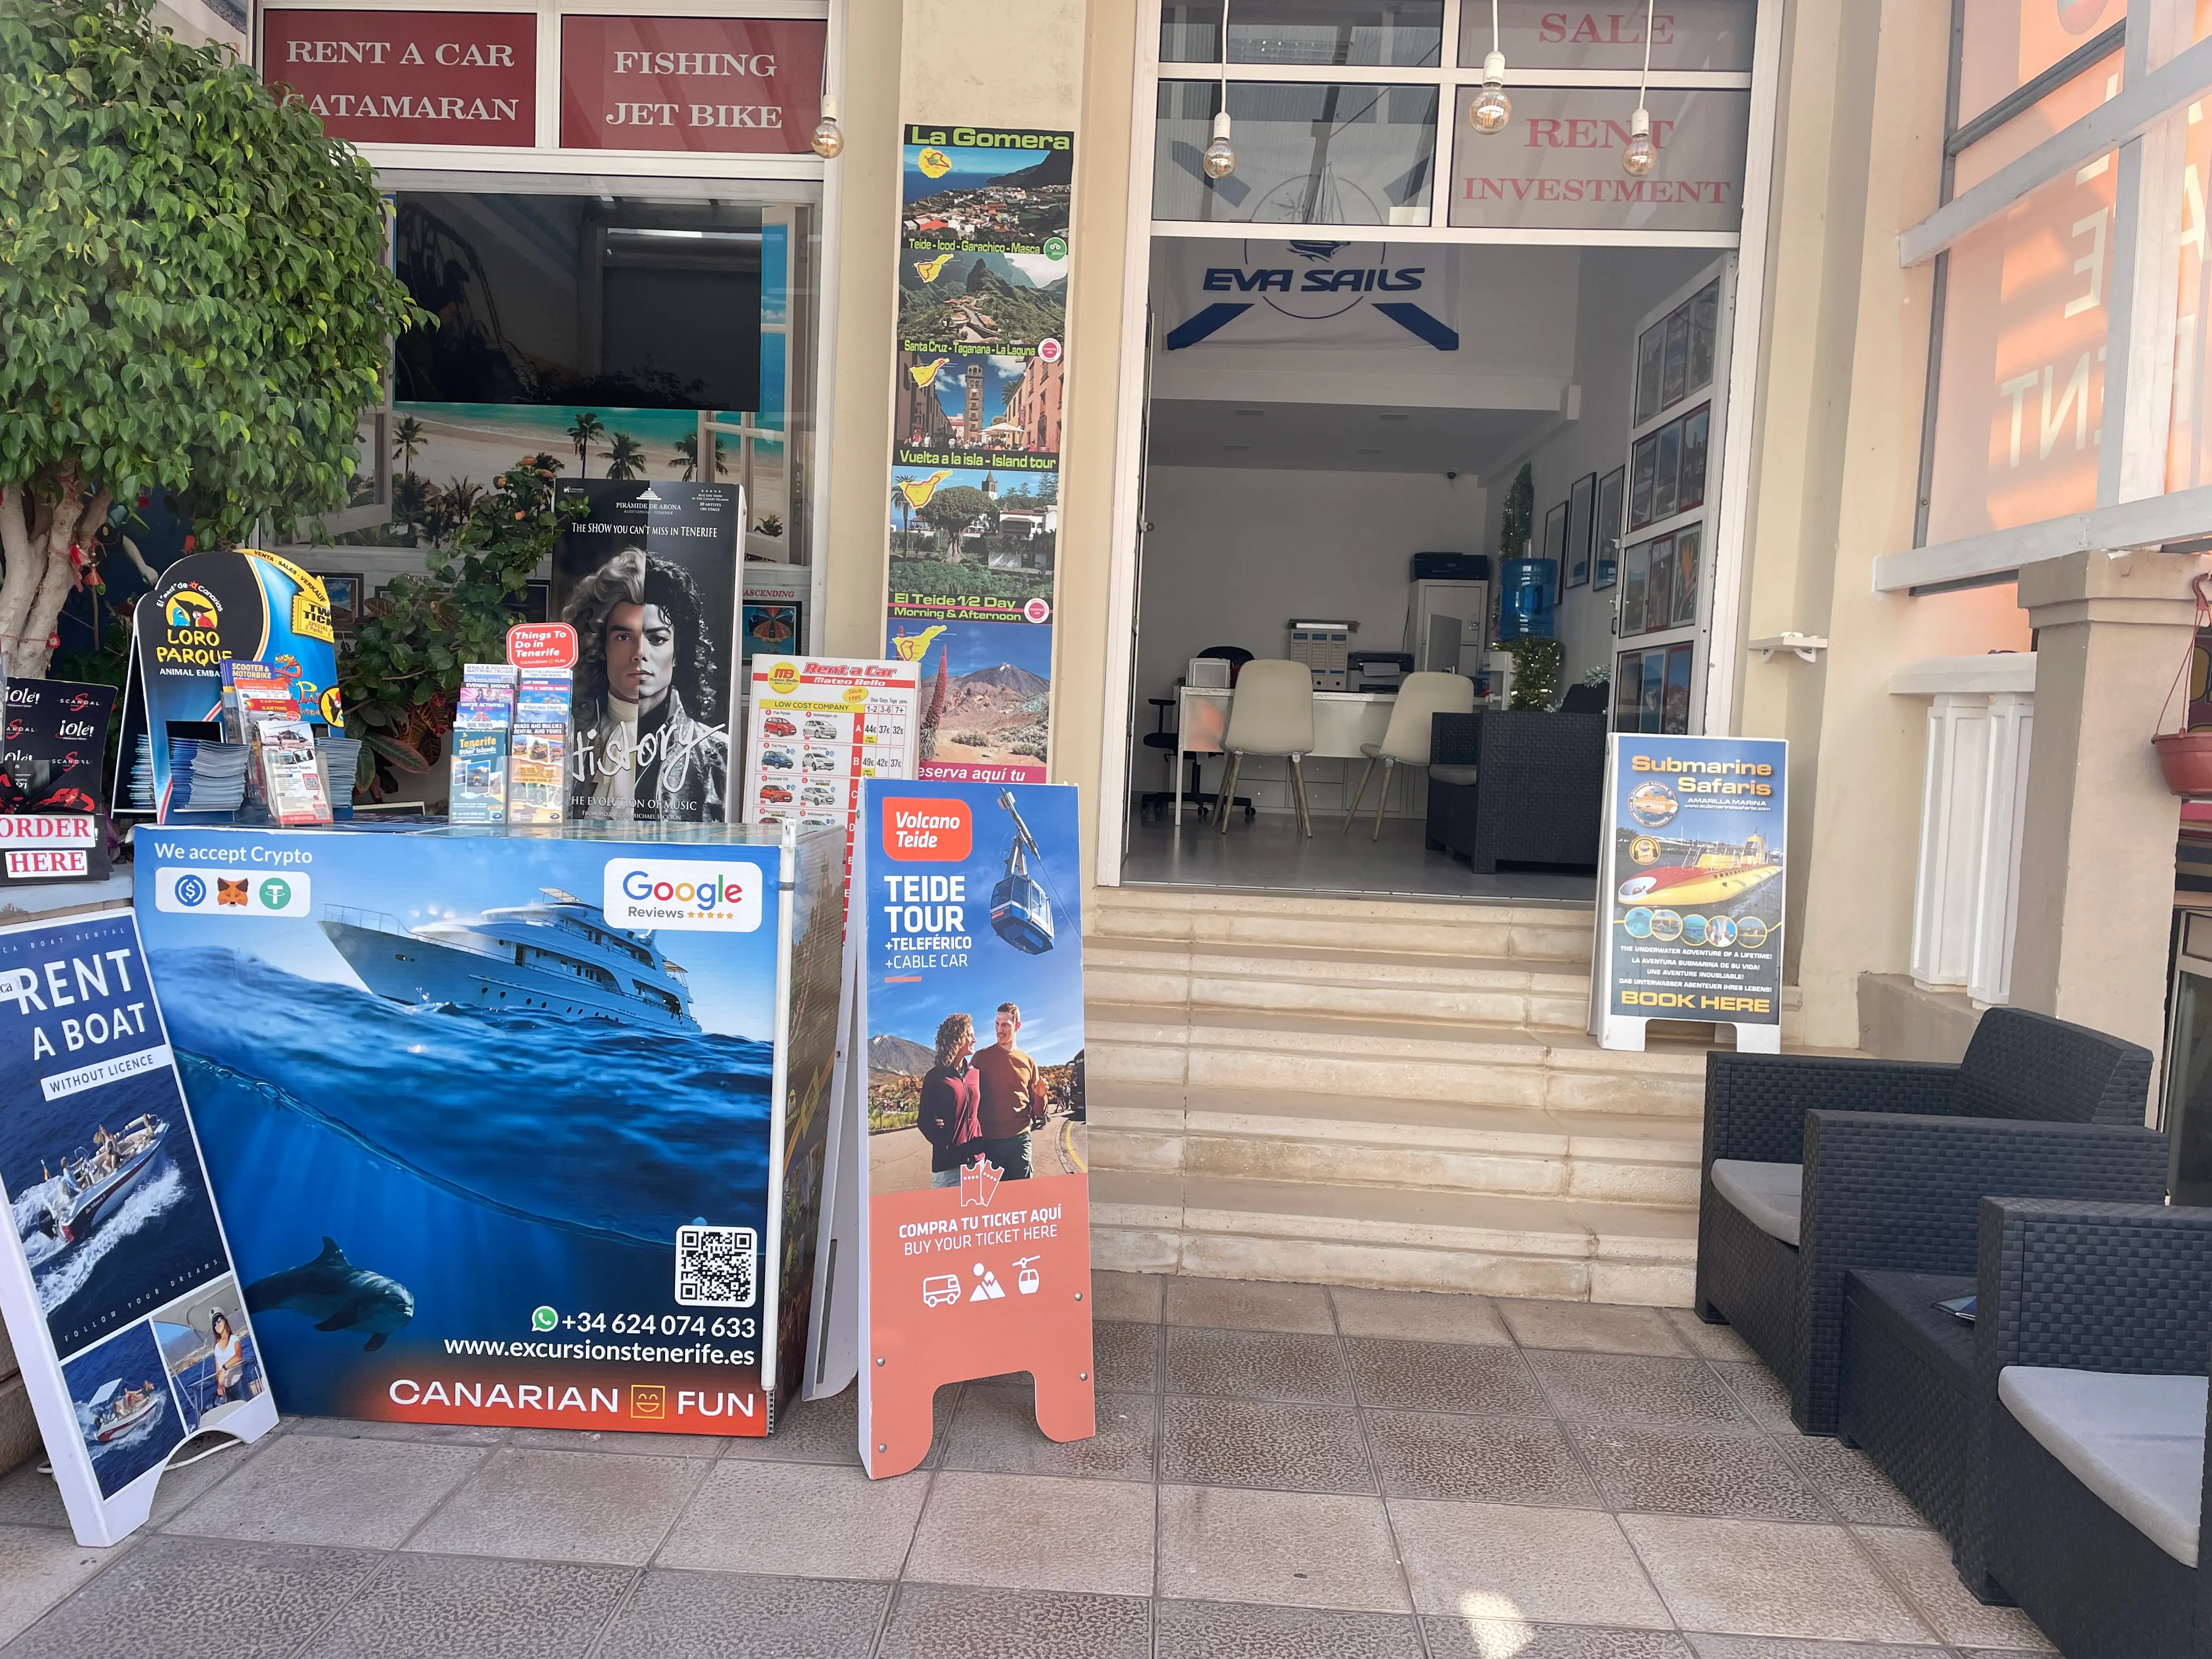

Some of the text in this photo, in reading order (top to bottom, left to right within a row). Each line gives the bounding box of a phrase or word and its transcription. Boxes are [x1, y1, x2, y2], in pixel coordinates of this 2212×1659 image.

[1539, 13, 1675, 46] SALE
[286, 41, 515, 67] RENT A CAR
[613, 51, 776, 78] FISHING
[605, 103, 783, 128] JET BIKE
[912, 126, 1069, 150] La Gomera
[1525, 118, 1674, 148] RENT
[1462, 177, 1730, 205] INVESTMENT
[909, 238, 931, 249] Teide
[937, 239, 955, 251] Icod
[962, 240, 1005, 252] Garachico
[1012, 242, 1040, 253] Masca
[1203, 267, 1425, 292] EVA SAILS
[905, 340, 927, 351] Santa
[929, 341, 947, 352] Cruz
[953, 342, 990, 356] Taganana
[996, 345, 1006, 354] La
[1007, 346, 1035, 358] Laguna
[900, 450, 1056, 469] Vuelta a la isla Island tour
[588, 523, 612, 534] SHOW
[613, 526, 628, 534] YOU
[630, 524, 650, 535] CAN'T
[652, 527, 668, 535] MISS
[681, 527, 717, 538] TENERIFE
[254, 550, 326, 603] VENTA SALES VERKAUF
[894, 593, 908, 603] El
[911, 594, 955, 605] Teide
[984, 597, 1015, 611] Day
[894, 607, 944, 619] Morning
[959, 611, 1021, 620] Afternoon
[167, 629, 219, 647] LORO
[515, 631, 551, 640] Things
[515, 648, 560, 657] Tenerife
[160, 668, 194, 676] ANIMAL
[232, 663, 263, 672] SCOOTER
[233, 671, 272, 679] MOTORBIKE
[803, 662, 897, 677] Rent a Car
[814, 677, 852, 685] Mateo
[59, 698, 100, 707] SCANDAL
[59, 720, 94, 737] ¡Olé!
[865, 725, 876, 733] 44€
[460, 736, 496, 748] Tenerife
[863, 758, 874, 766] 49€
[1632, 755, 1772, 776] Submarine
[1678, 777, 1771, 796] Safaris
[0, 817, 91, 838] ORDER
[896, 811, 960, 830] Volcano
[896, 831, 938, 848] Teide
[9, 850, 85, 873] HERE
[154, 842, 313, 866] We accept Crypto
[623, 871, 742, 911] Google
[884, 876, 966, 903] TEIDE
[628, 906, 684, 918] Reviews
[884, 905, 966, 933] TOUR
[31, 938, 64, 949] BOAT
[76, 928, 125, 941] RENTAL
[885, 934, 972, 951] +TELEFÉRICO
[885, 954, 968, 969] +CABLE CAR
[18, 949, 131, 1015] RENT
[1622, 991, 1770, 1013] BOOK HERE
[33, 1002, 145, 1060] A BOAT
[49, 1054, 154, 1093] WITHOUT LICENCE
[899, 1203, 1062, 1239] COMPRA TU TICKET AQUÍ
[904, 1224, 1057, 1256] BUY YOUR TICKET HERE
[64, 1259, 218, 1342] FOLLOW YOUR DREAMS
[562, 1313, 755, 1338] +34 624 074 633
[444, 1338, 754, 1365] www.excursionstenerife.es
[389, 1379, 754, 1418] CANARIAN FUN
